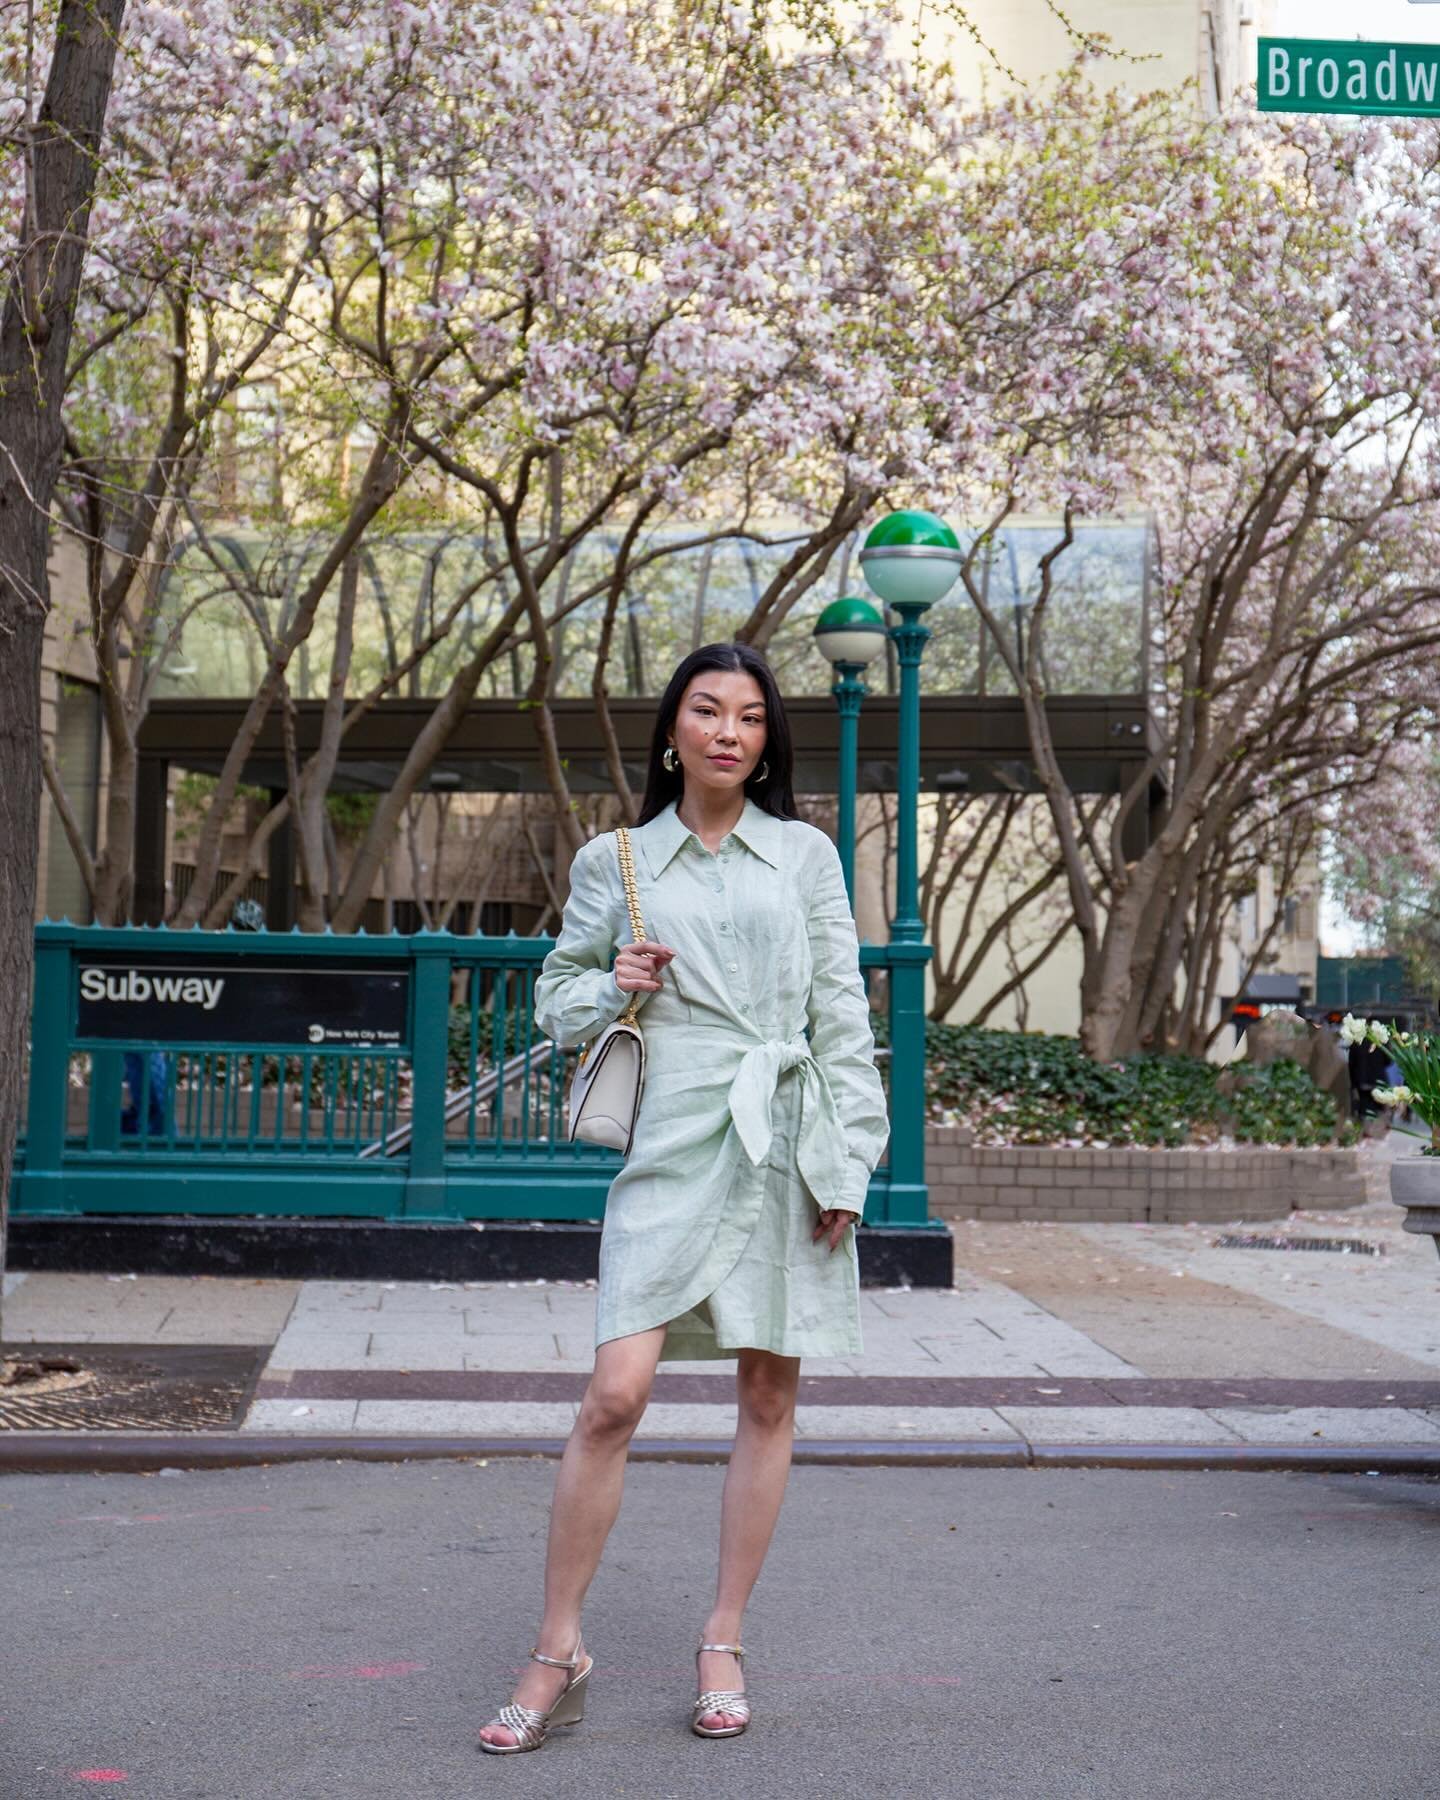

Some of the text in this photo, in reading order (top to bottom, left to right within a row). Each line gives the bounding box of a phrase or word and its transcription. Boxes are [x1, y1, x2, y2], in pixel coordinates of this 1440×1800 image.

[1268, 47, 1438, 102] Broadw
[80, 968, 225, 1010] Subway
[325, 1030, 342, 1039] New
[343, 1030, 359, 1039] York
[360, 1030, 375, 1040] City
[376, 1030, 400, 1040] Transit
